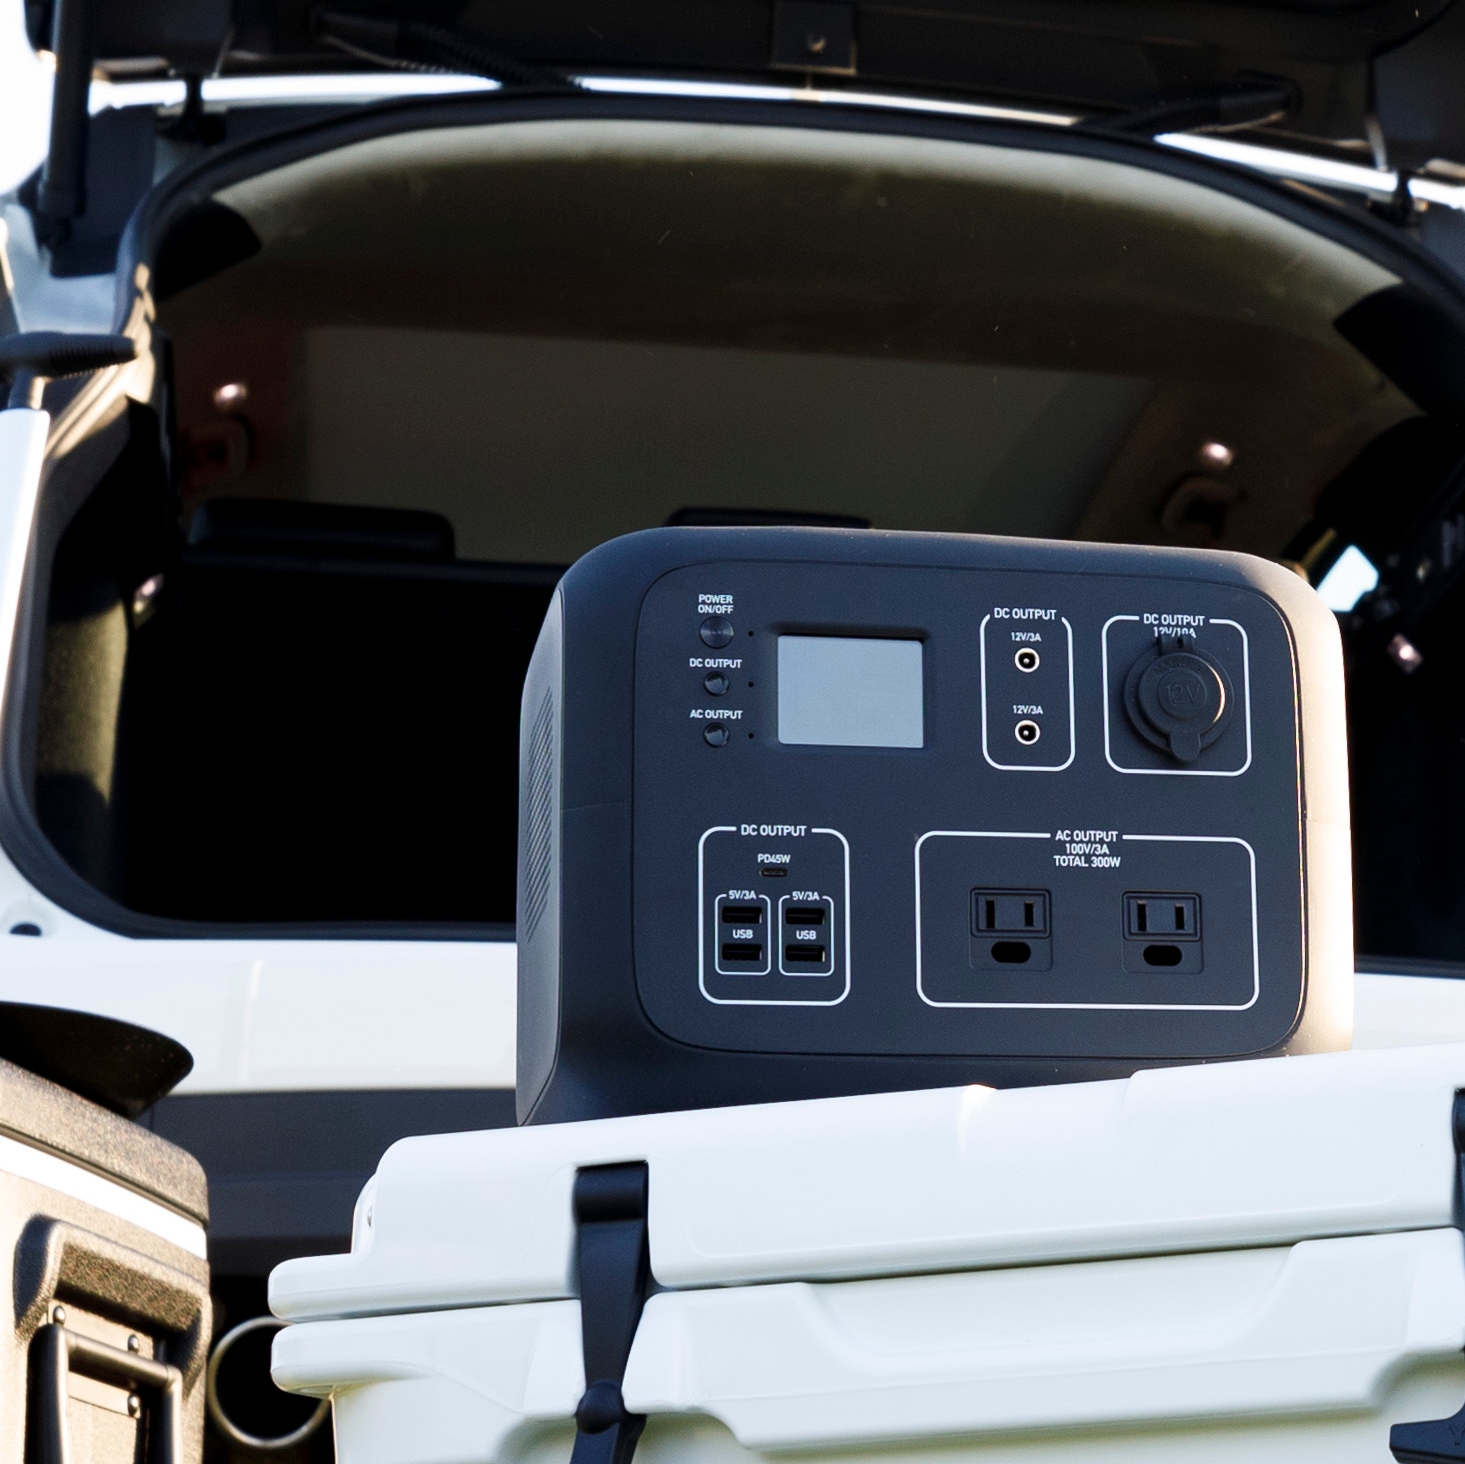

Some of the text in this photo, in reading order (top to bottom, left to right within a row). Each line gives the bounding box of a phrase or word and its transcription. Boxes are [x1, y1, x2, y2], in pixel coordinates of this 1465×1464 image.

[698, 594, 734, 604] POWER
[697, 604, 734, 614] ON/OFF
[993, 607, 1057, 621] DC OUTPUT
[1143, 613, 1205, 626] DC OUTPUT
[1011, 631, 1042, 642] 12V/3A
[689, 658, 743, 668] DC OUTPUT
[689, 709, 743, 720] AC OUTPUT
[1012, 704, 1044, 715] 12V/3A
[740, 824, 807, 837] DC OUTPUT
[1055, 829, 1119, 842] AC OUTPUT
[1065, 842, 1110, 855] 100V/3A
[757, 853, 791, 864] PD45W
[1053, 855, 1121, 868] TOTAL 300W
[728, 889, 757, 900] 5V/3A
[792, 891, 820, 901] 5V/3A
[732, 929, 753, 939] USB
[796, 930, 816, 940] USB
